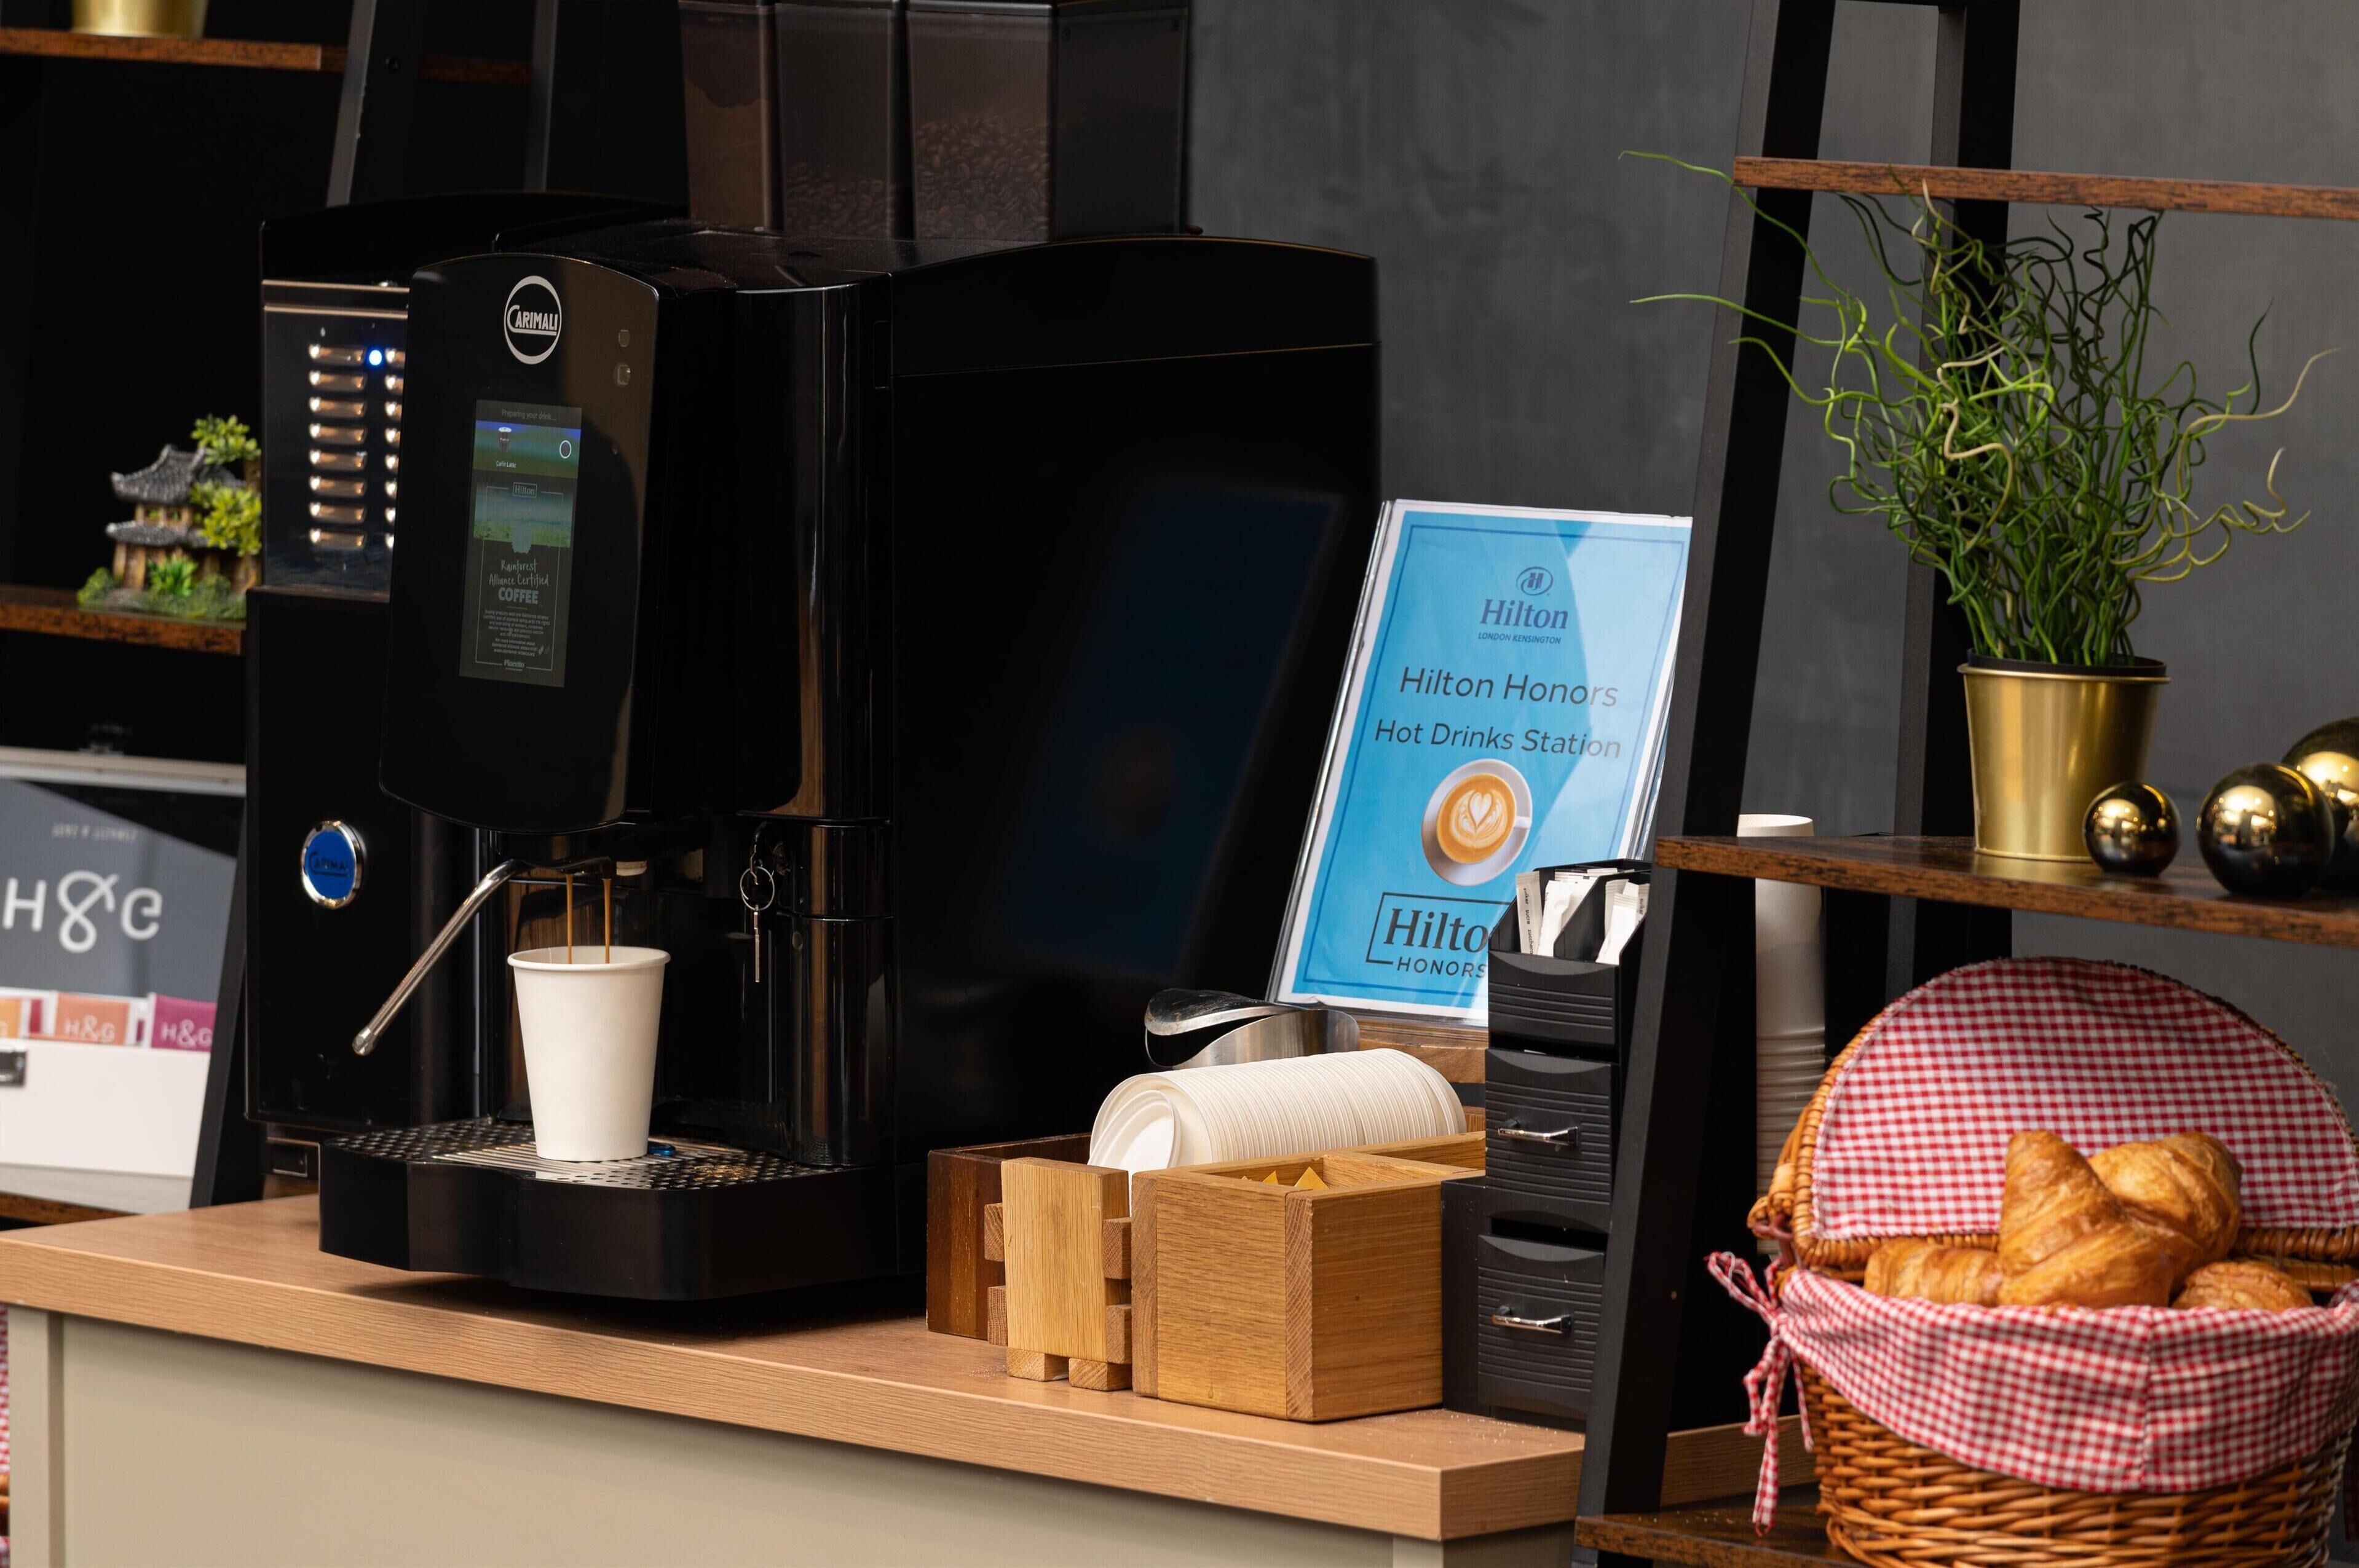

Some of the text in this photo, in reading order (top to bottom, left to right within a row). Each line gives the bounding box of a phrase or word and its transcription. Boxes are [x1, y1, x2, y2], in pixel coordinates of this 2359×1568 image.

[507, 305, 558, 336] CARIMALI
[502, 408, 526, 420] Preparing
[515, 484, 535, 495] Hilton
[501, 559, 537, 574] Rainforest
[489, 573, 549, 588] Alliance Certified
[498, 587, 539, 605] COFFEE
[1479, 598, 1568, 630] Hilton
[1477, 632, 1562, 645] LONDON KENSINGTON
[1399, 666, 1619, 707] Hilton Honors
[1374, 719, 1621, 759] Hot Drinks Station
[1383, 907, 1489, 953] Hilto
[1396, 956, 1487, 979] HONORS
[64, 1014, 116, 1043] H&G
[160, 1018, 213, 1049] H&G
